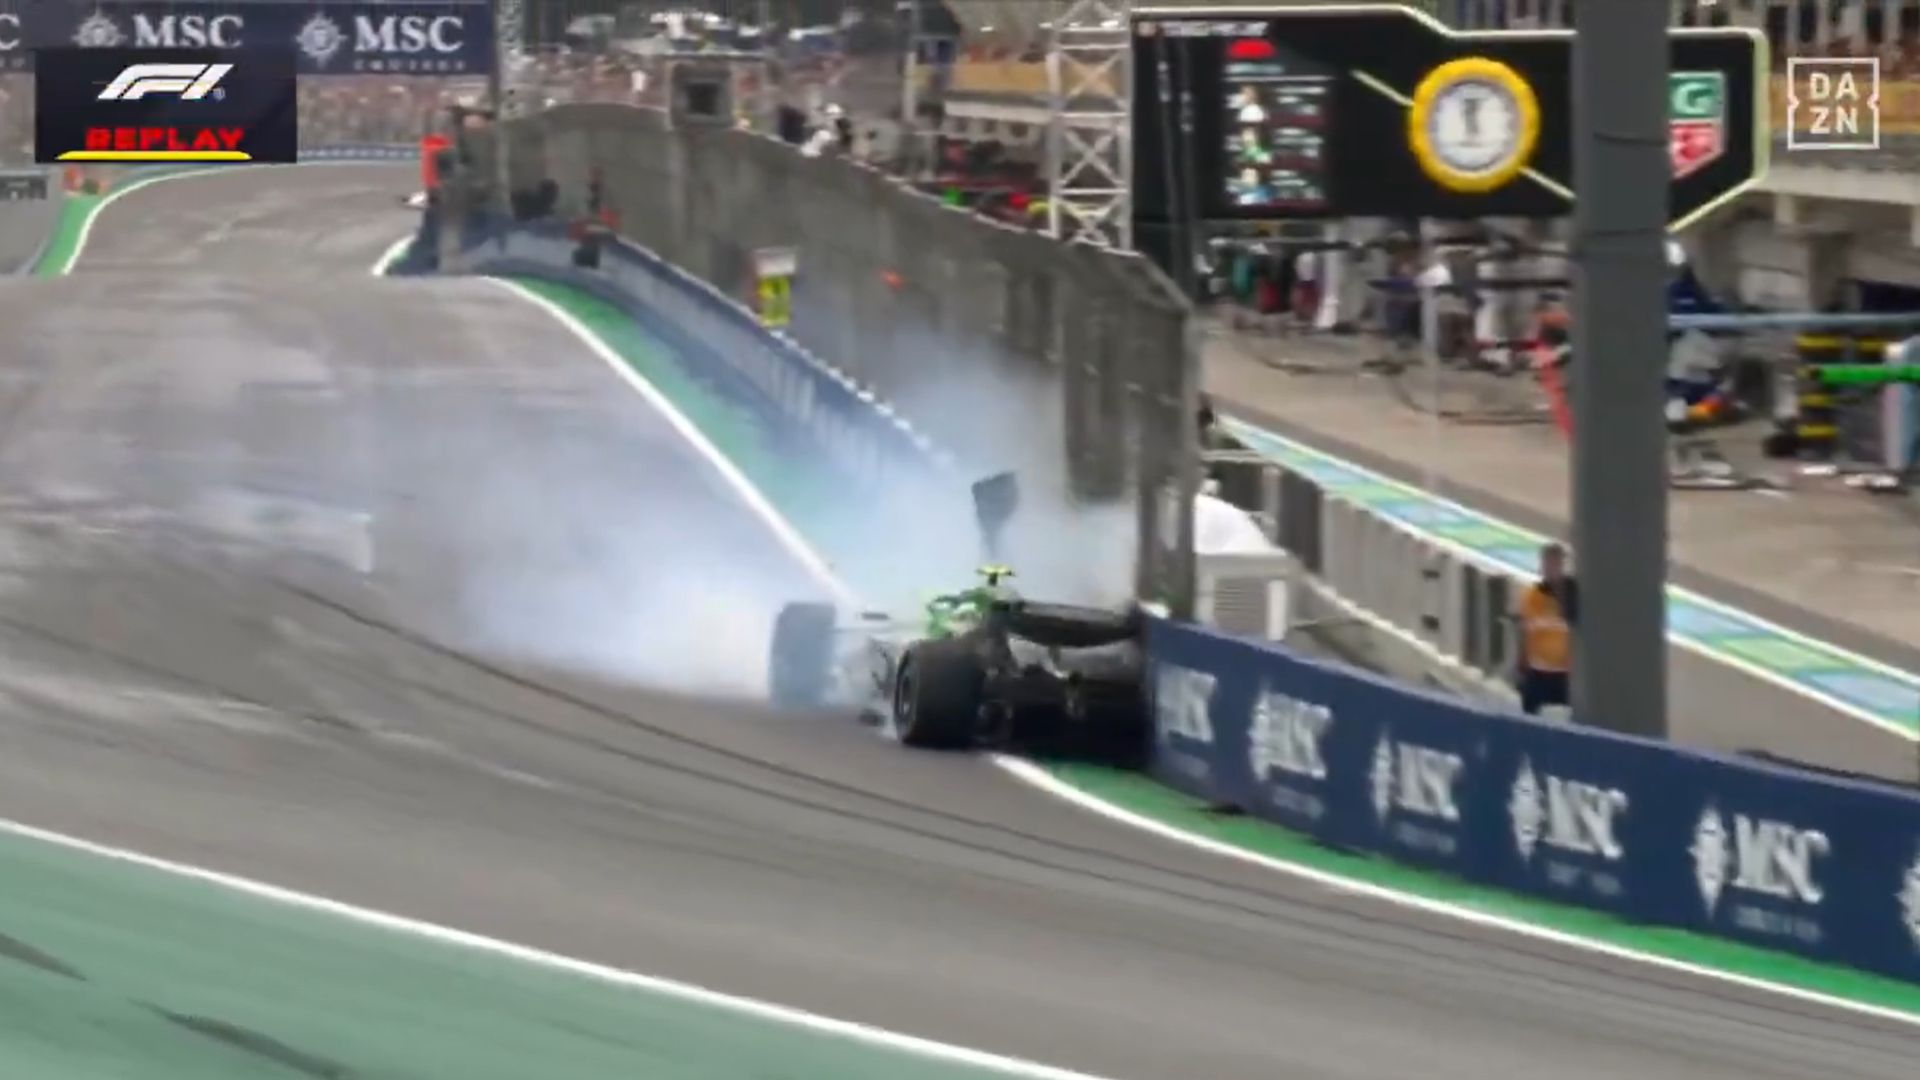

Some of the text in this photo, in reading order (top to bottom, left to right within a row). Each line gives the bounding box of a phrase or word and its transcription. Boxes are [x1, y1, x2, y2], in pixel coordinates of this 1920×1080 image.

[131, 14, 244, 48] MSC
[353, 15, 464, 53] MSC
[1543, 773, 1629, 861] MSC
[1731, 812, 1831, 904] MSC
